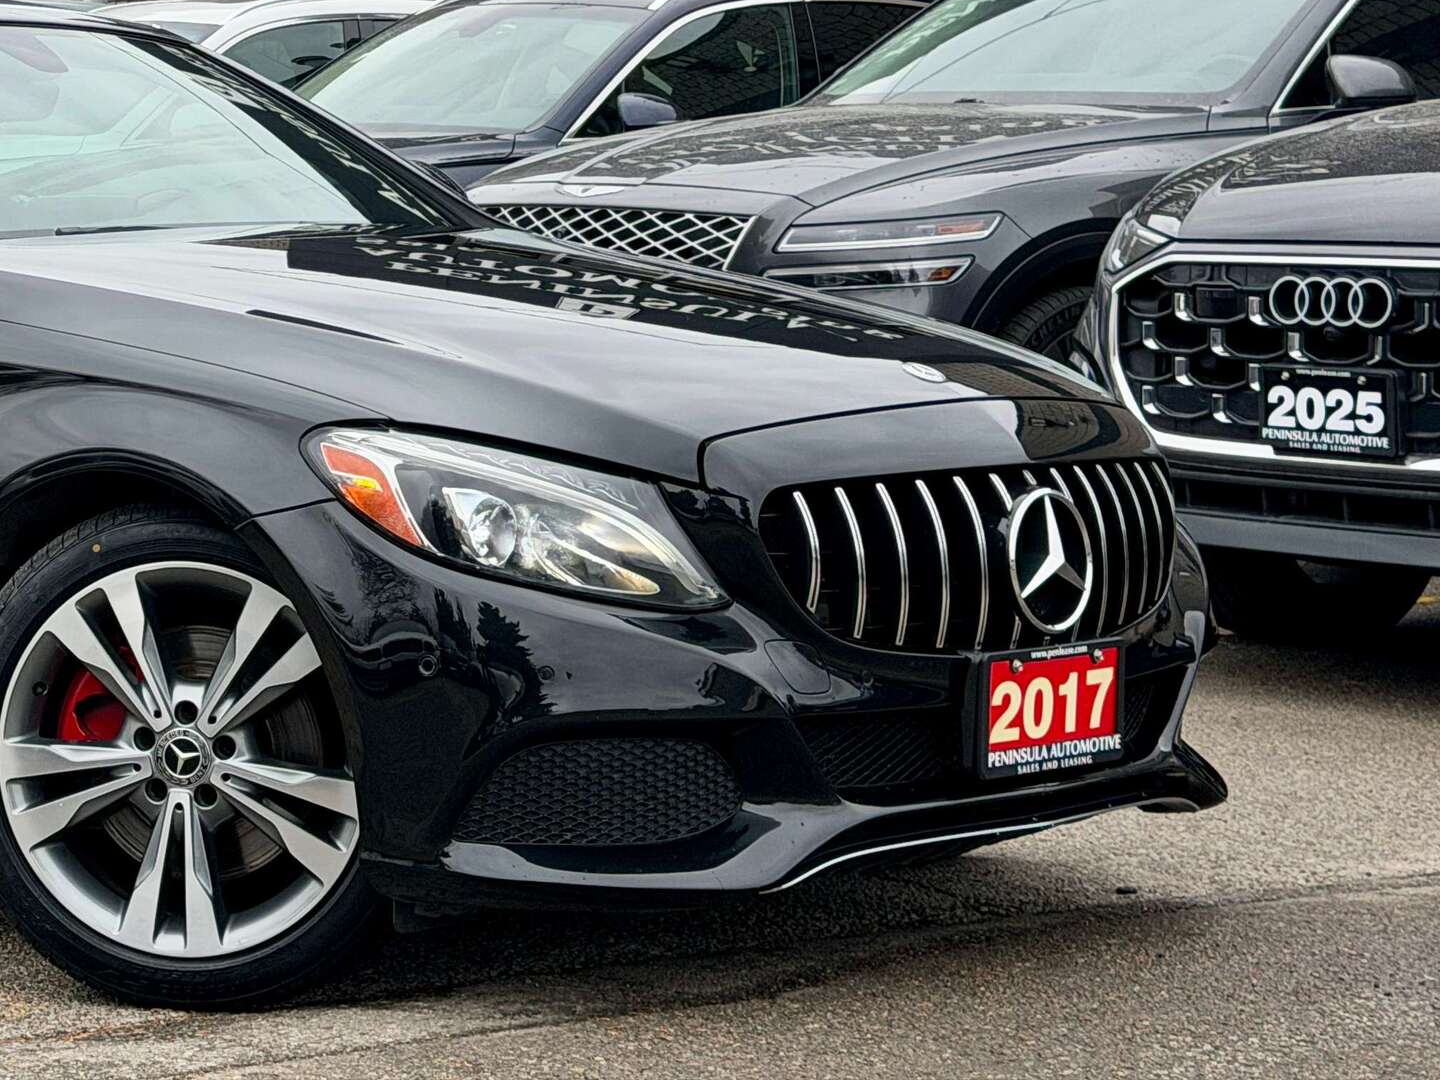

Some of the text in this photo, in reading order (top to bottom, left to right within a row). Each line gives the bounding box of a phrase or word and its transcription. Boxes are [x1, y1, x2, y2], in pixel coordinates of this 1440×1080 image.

[1266, 384, 1386, 435] 2025
[1262, 427, 1390, 449] PENINSULA AUTOMOTIVE
[1289, 441, 1361, 453] SALES AND LEASING
[988, 666, 1115, 745] 2017
[987, 733, 1122, 768] PENINSULA AUTOMOTIVE
[1017, 755, 1093, 775] SALES AND LEASING
